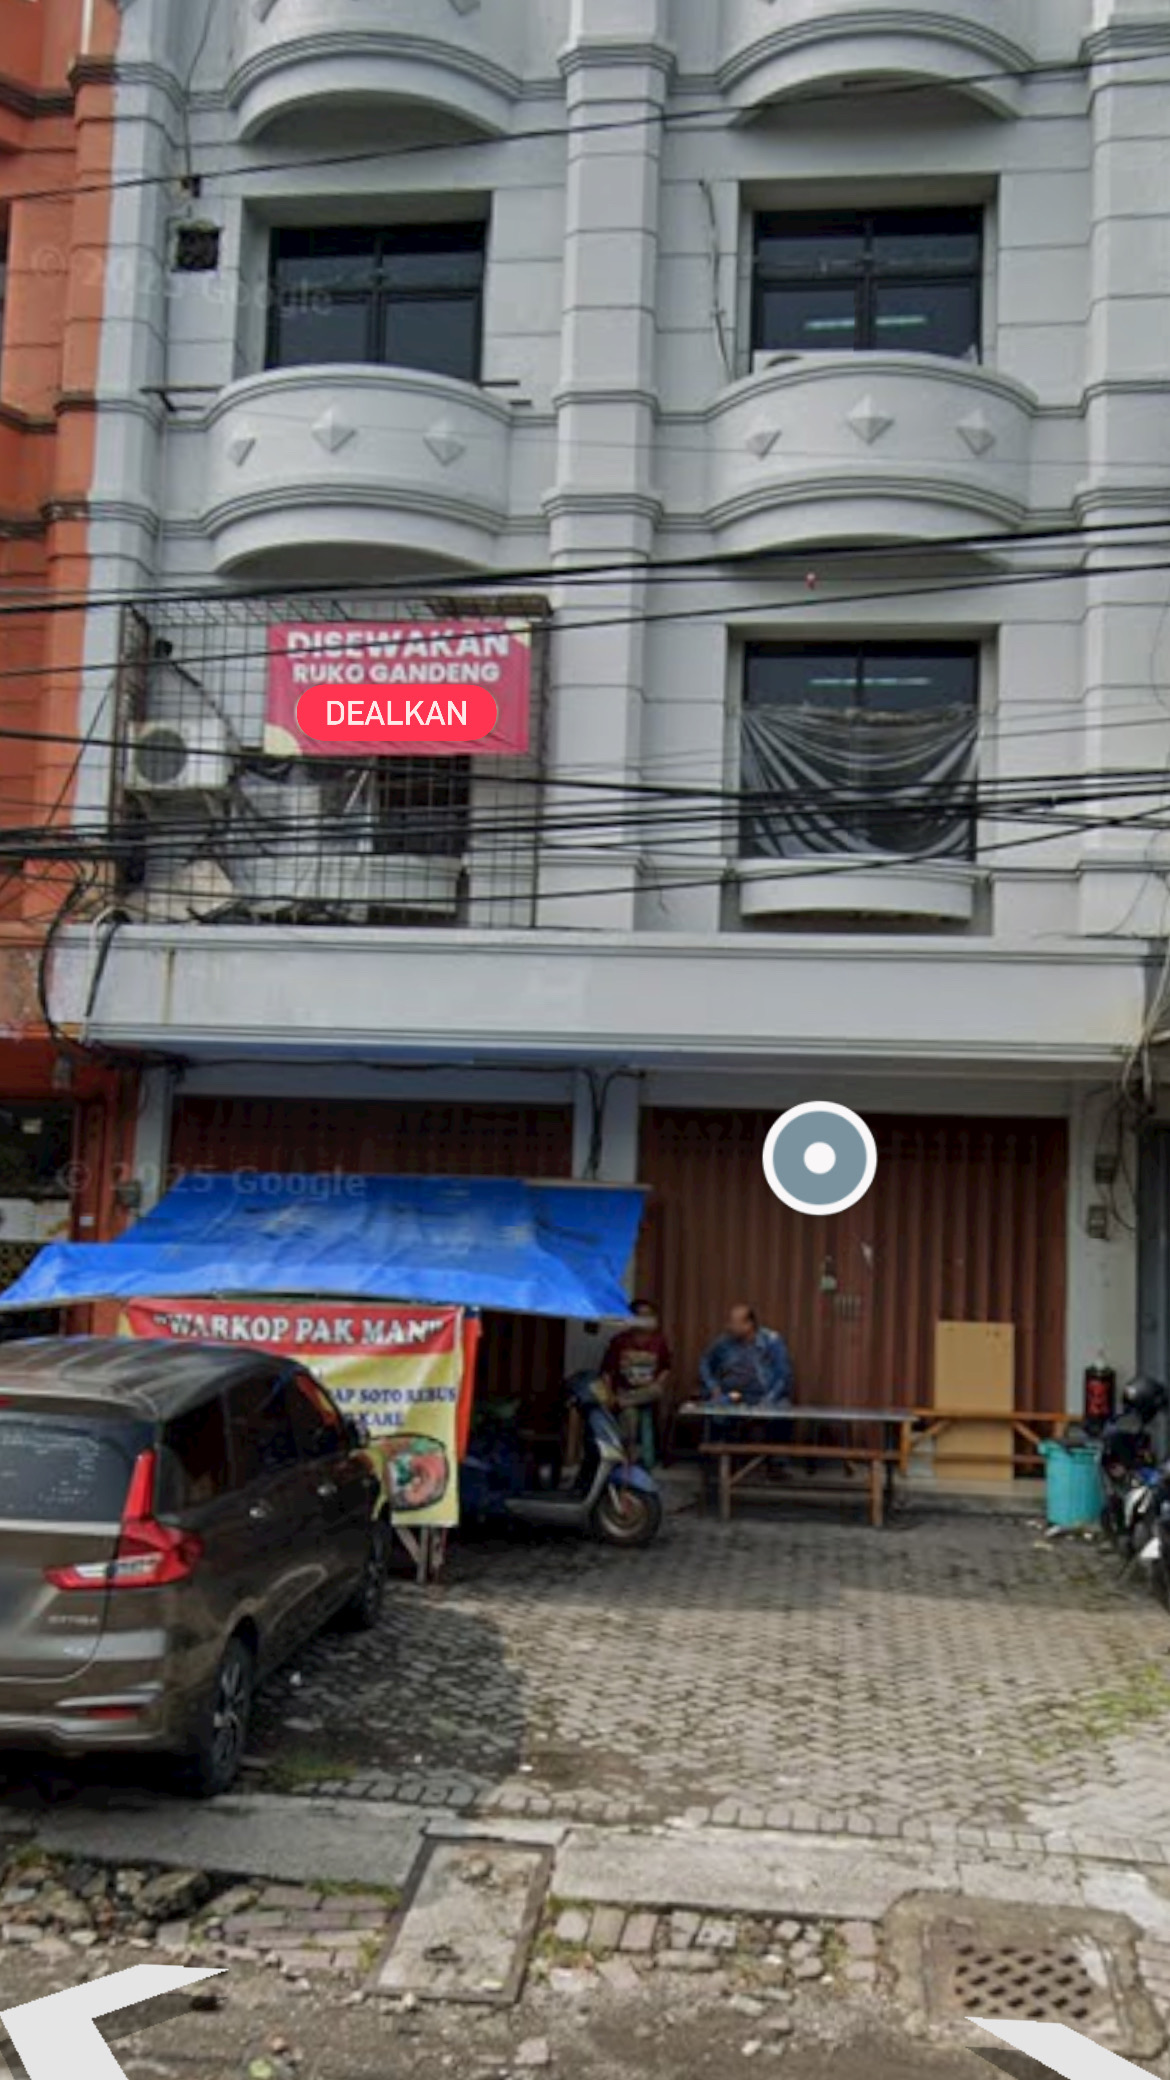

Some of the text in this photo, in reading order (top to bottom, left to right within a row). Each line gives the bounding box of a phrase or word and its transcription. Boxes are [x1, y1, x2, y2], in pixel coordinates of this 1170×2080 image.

[286, 631, 510, 658] DISEWAKAN
[293, 662, 500, 684] RUKO GANDENG
[295, 1317, 354, 1345] PAK
[359, 1388, 403, 1402] SOTO
